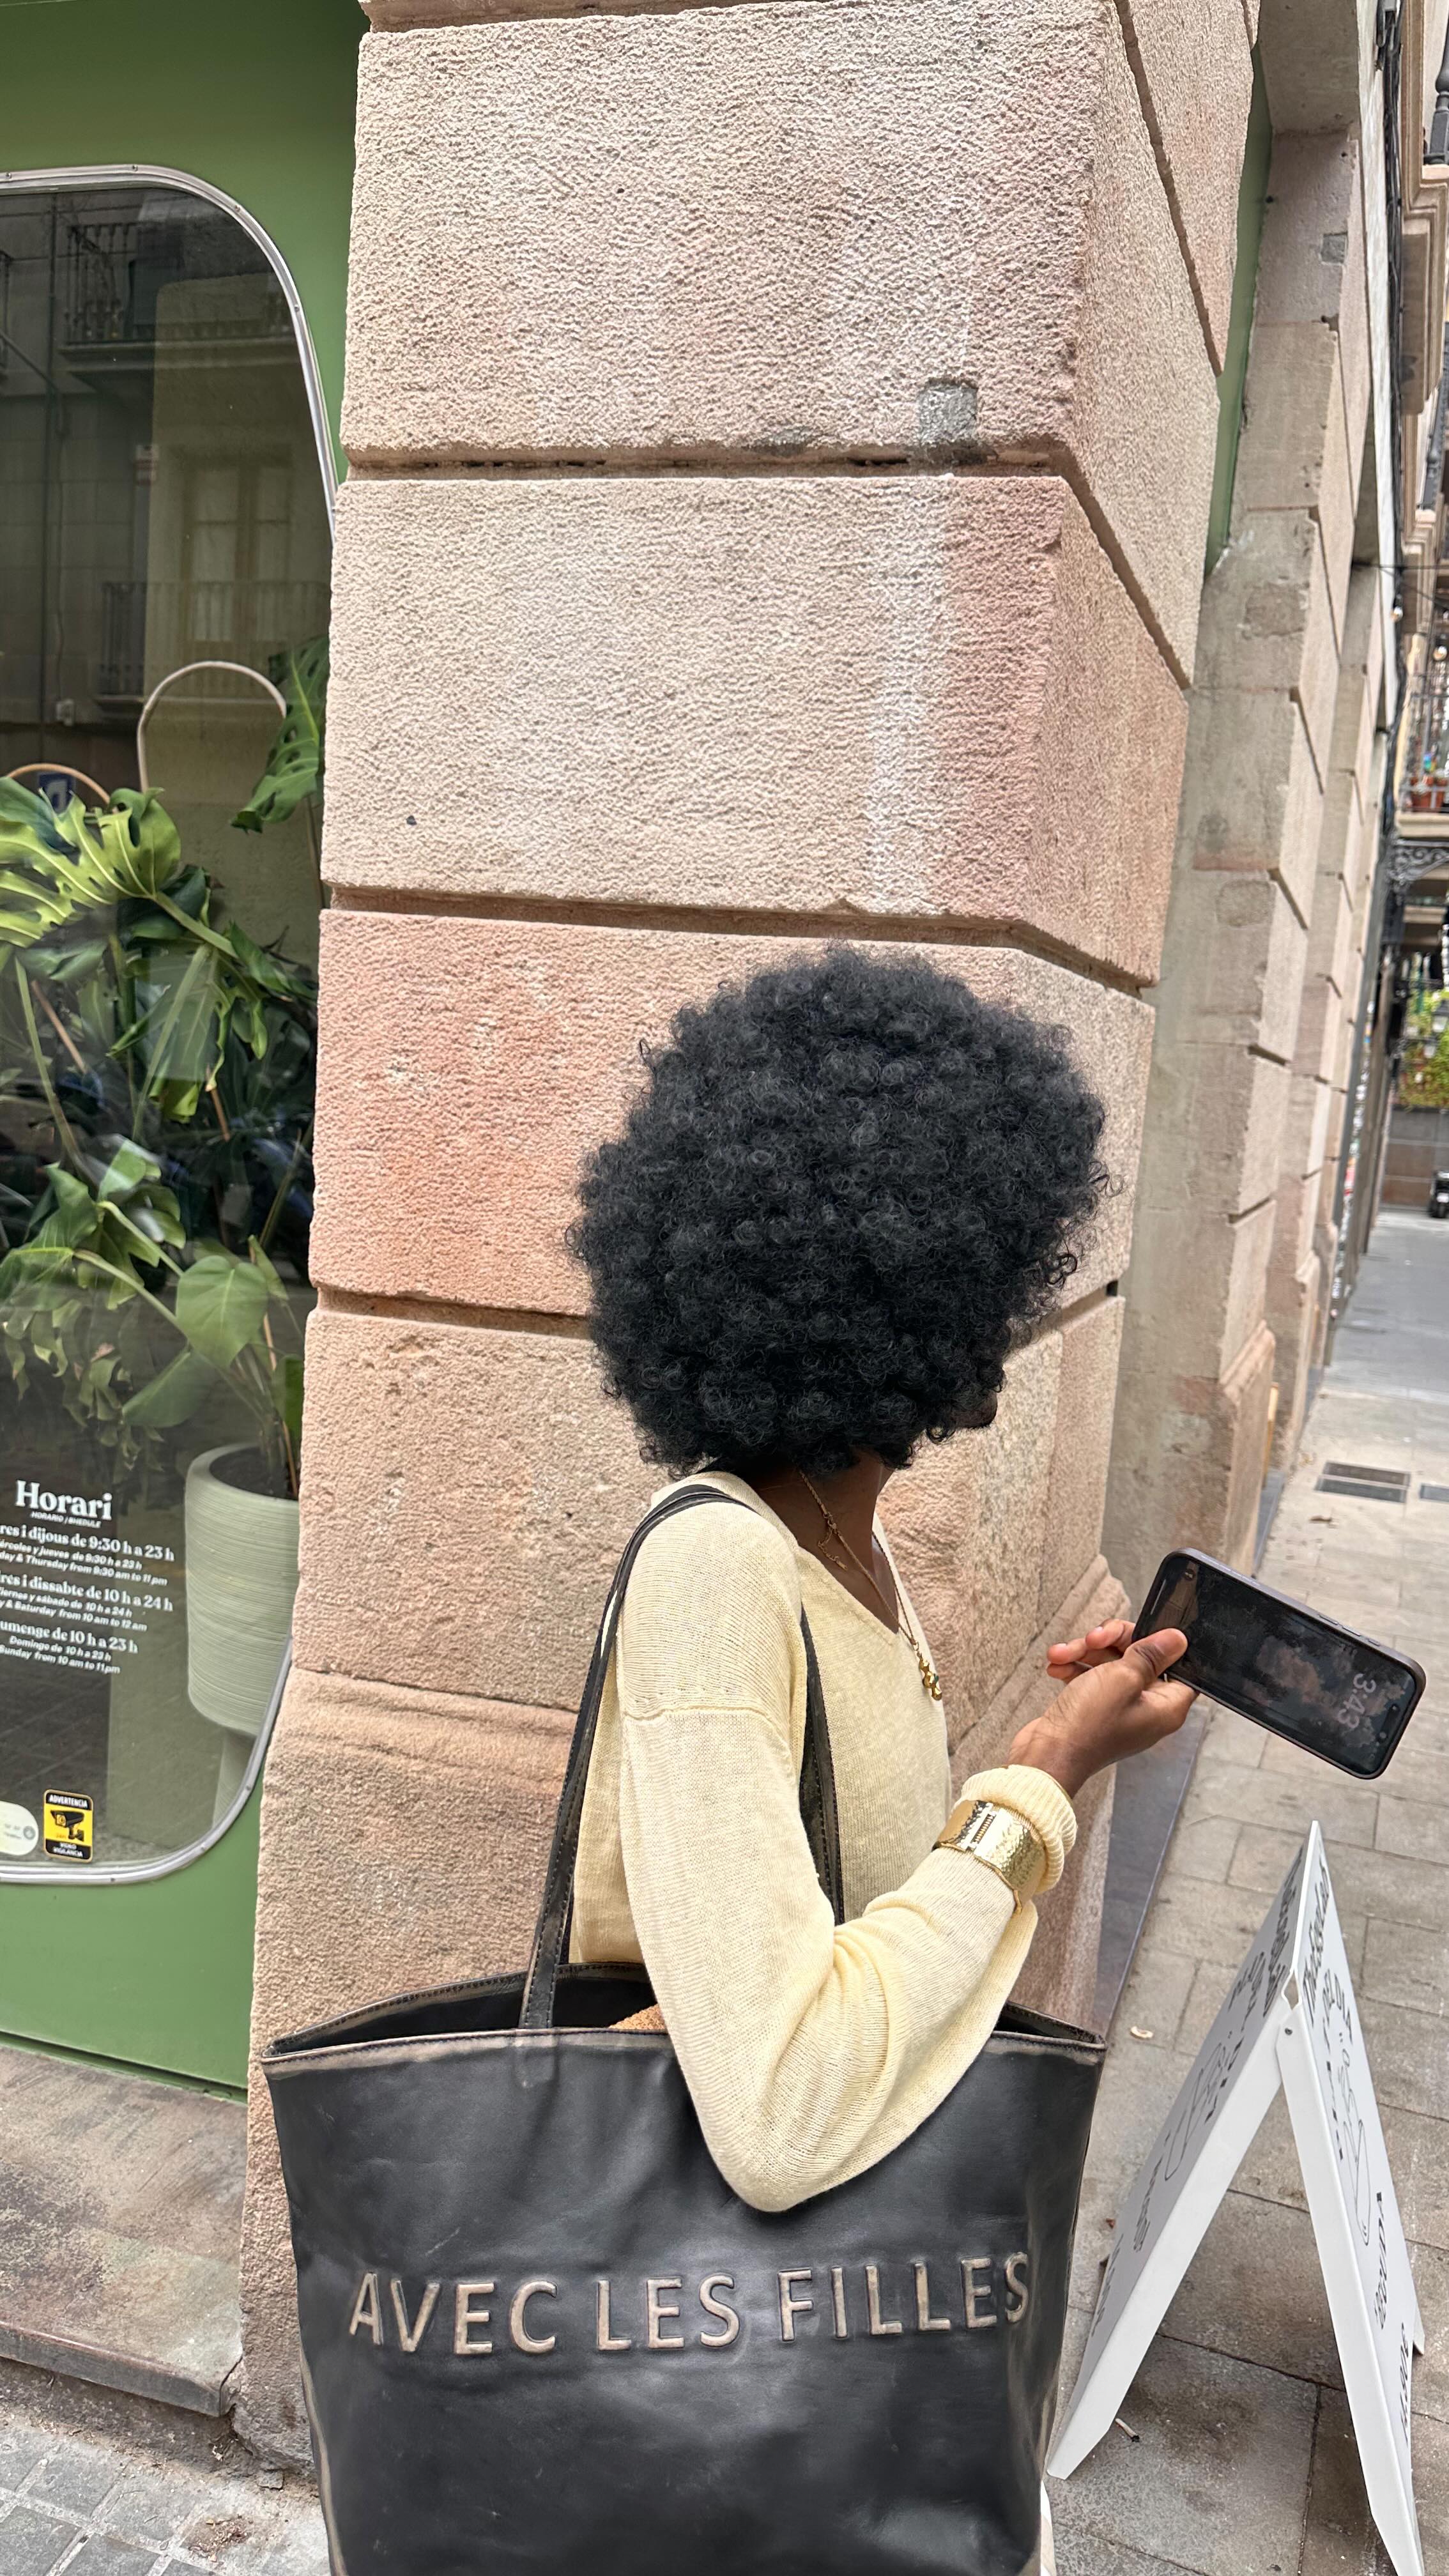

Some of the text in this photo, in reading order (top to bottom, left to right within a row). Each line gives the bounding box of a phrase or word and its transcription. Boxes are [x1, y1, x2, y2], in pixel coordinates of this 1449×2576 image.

[15, 1480, 112, 1520] Horari
[30, 1511, 64, 1522] HORARIO
[20, 1524, 27, 1538] i
[28, 1526, 69, 1544] dijous
[71, 1533, 88, 1548] de
[89, 1536, 121, 1553] 9:30
[123, 1540, 132, 1555] h
[134, 1546, 143, 1557] a
[144, 1545, 164, 1560] 23
[165, 1547, 174, 1562] h
[15, 1553, 24, 1563] &
[26, 1554, 68, 1572] Thursday
[69, 1561, 93, 1574] from
[93, 1565, 114, 1577] 9:30
[115, 1572, 130, 1580] am
[131, 1572, 142, 1582] to
[142, 1574, 152, 1583] 11
[150, 1577, 168, 1586] pm
[38, 1546, 70, 1559] jueves
[72, 1551, 84, 1562] de
[85, 1553, 107, 1565] 9:30
[107, 1556, 114, 1567] h
[115, 1560, 121, 1568] a
[122, 1559, 135, 1570] 23
[135, 1561, 142, 1570] h
[22, 1574, 27, 1588] i
[28, 1576, 84, 1597] dissabte
[86, 1585, 102, 1600] de
[104, 1588, 120, 1602] 10
[121, 1590, 131, 1605] h
[132, 1596, 142, 1607] a
[143, 1595, 161, 1609] 24
[164, 1597, 173, 1612] h
[14, 1600, 57, 1618] Saturday
[58, 1608, 82, 1621] from
[82, 1613, 94, 1623] 10
[94, 1616, 109, 1626] am
[110, 1618, 120, 1628] to
[121, 1619, 132, 1629] 12
[132, 1622, 148, 1632] am
[70, 1600, 83, 1610] de
[86, 1602, 97, 1612] 10
[96, 1604, 104, 1613] h
[111, 1606, 125, 1616] 24
[125, 1608, 133, 1618] h
[9, 1636, 50, 1651] Domingo
[50, 1643, 63, 1653] de
[66, 1646, 77, 1656] 10
[76, 1647, 84, 1657] h
[91, 1650, 104, 1660] 23
[104, 1652, 112, 1662] h
[52, 1627, 68, 1641] de
[70, 1630, 86, 1644] 10
[87, 1632, 96, 1647] h
[98, 1638, 107, 1648] a
[108, 1636, 126, 1652] 23
[128, 1639, 138, 1654] h
[33, 1651, 56, 1664] from
[57, 1655, 69, 1666] 10
[68, 1659, 84, 1668] am
[84, 1661, 95, 1671] to
[104, 1665, 121, 1675] pm
[1337, 1673, 1377, 1728] 3:43
[49, 1794, 88, 1808] ADVERTENCIA
[349, 2251, 1030, 2356] AVEC LES FILLES
